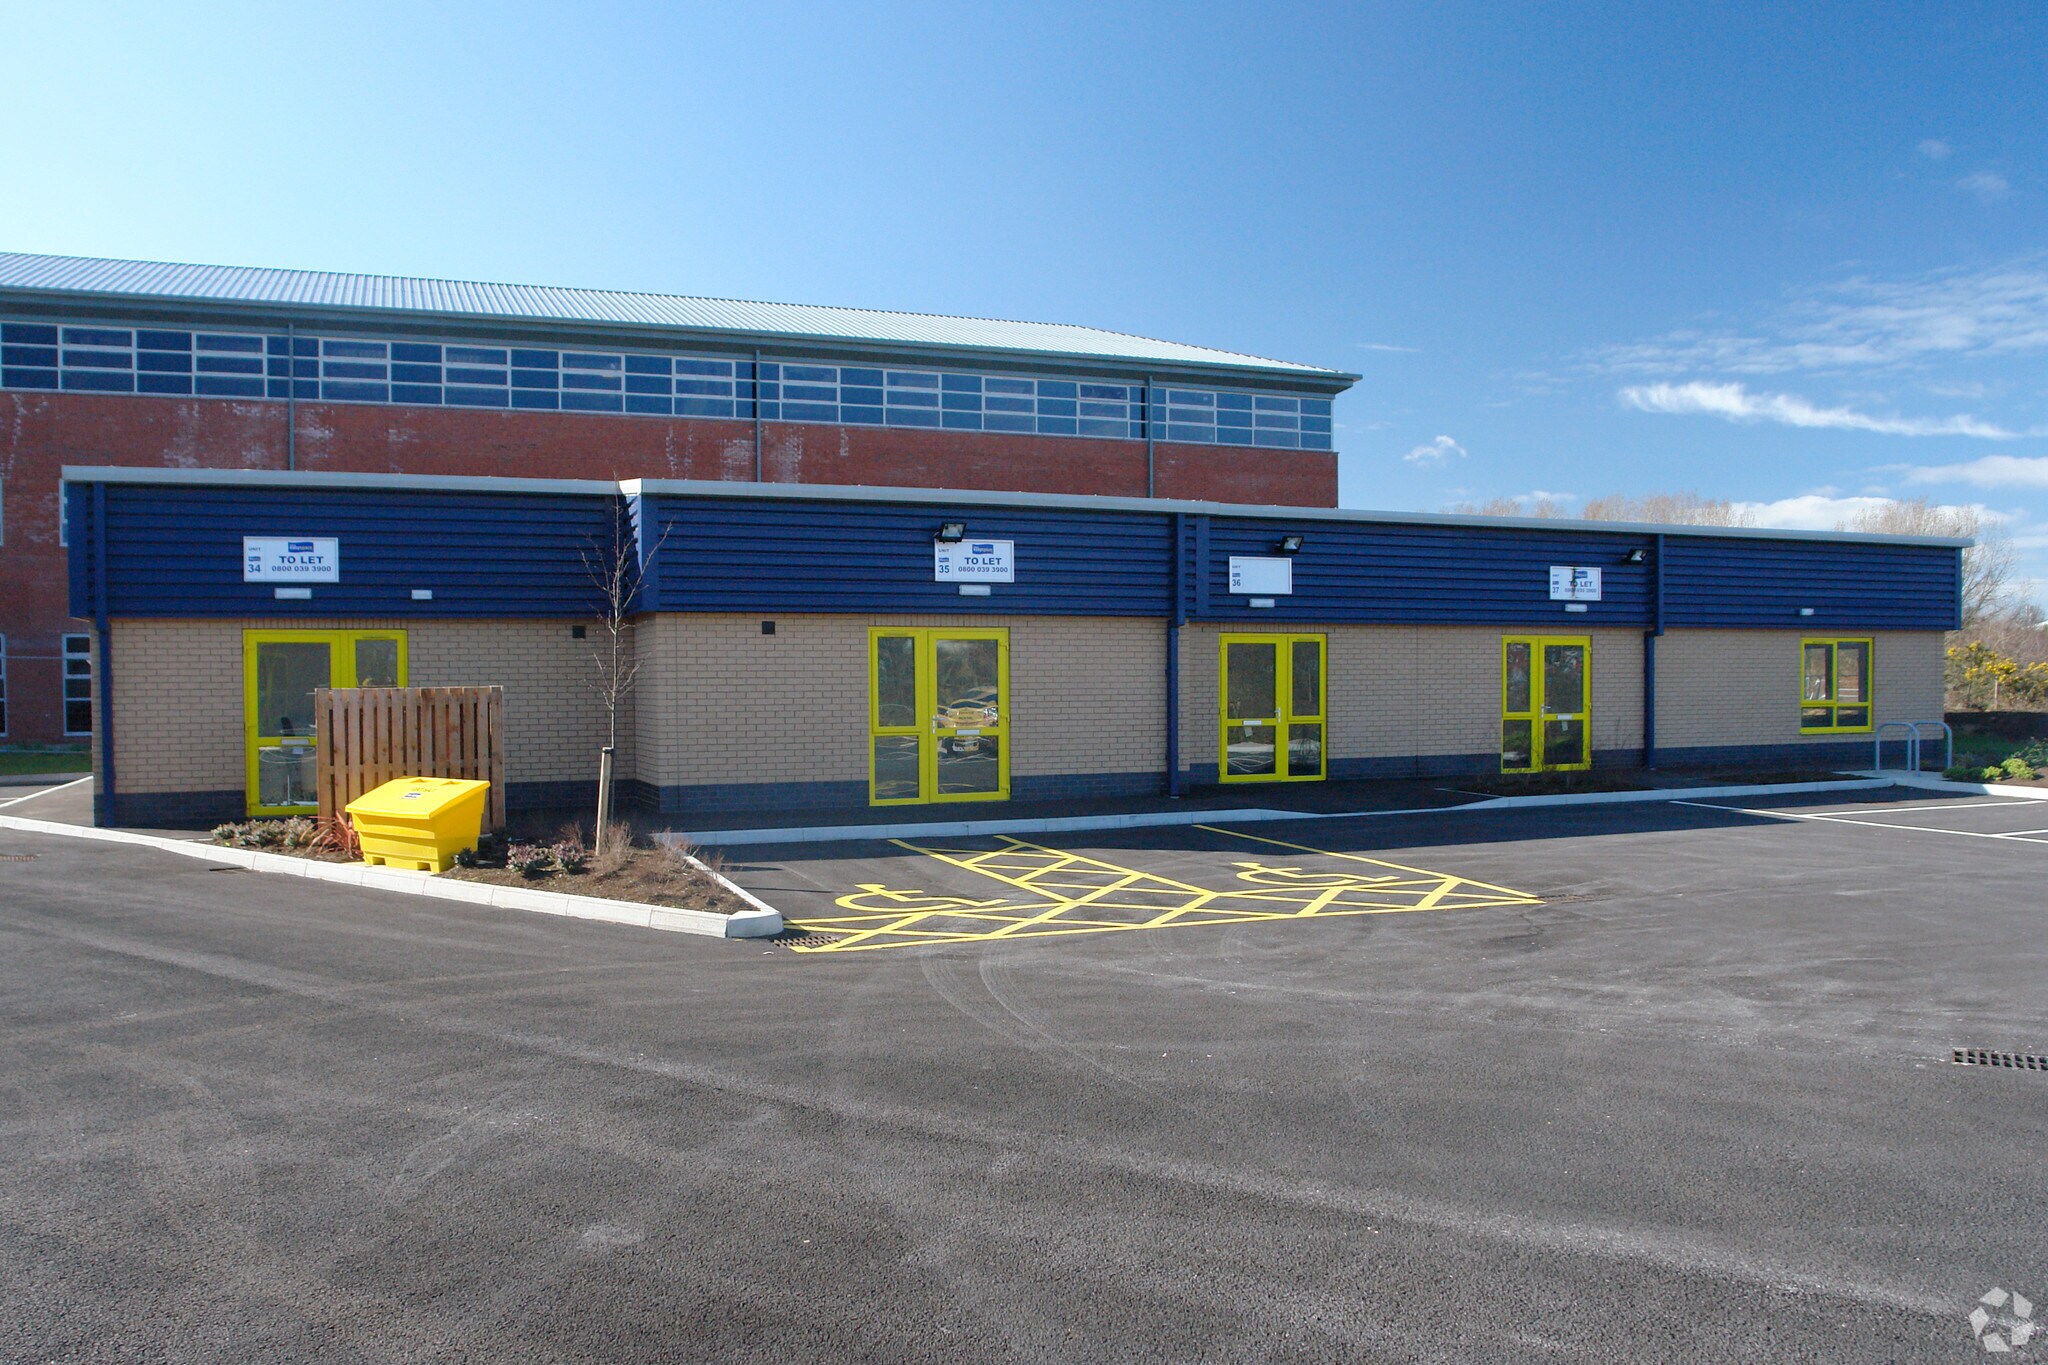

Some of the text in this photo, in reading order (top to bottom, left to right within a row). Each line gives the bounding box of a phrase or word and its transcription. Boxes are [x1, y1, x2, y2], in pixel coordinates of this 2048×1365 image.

[278, 555, 324, 564] TO LET
[964, 557, 1002, 566] TO LET
[247, 563, 261, 573] 34
[938, 564, 950, 574] 35
[1231, 578, 1242, 587] 36
[1568, 580, 1578, 588] TO
[1580, 580, 1593, 588] LET
[1552, 586, 1560, 594] 37
